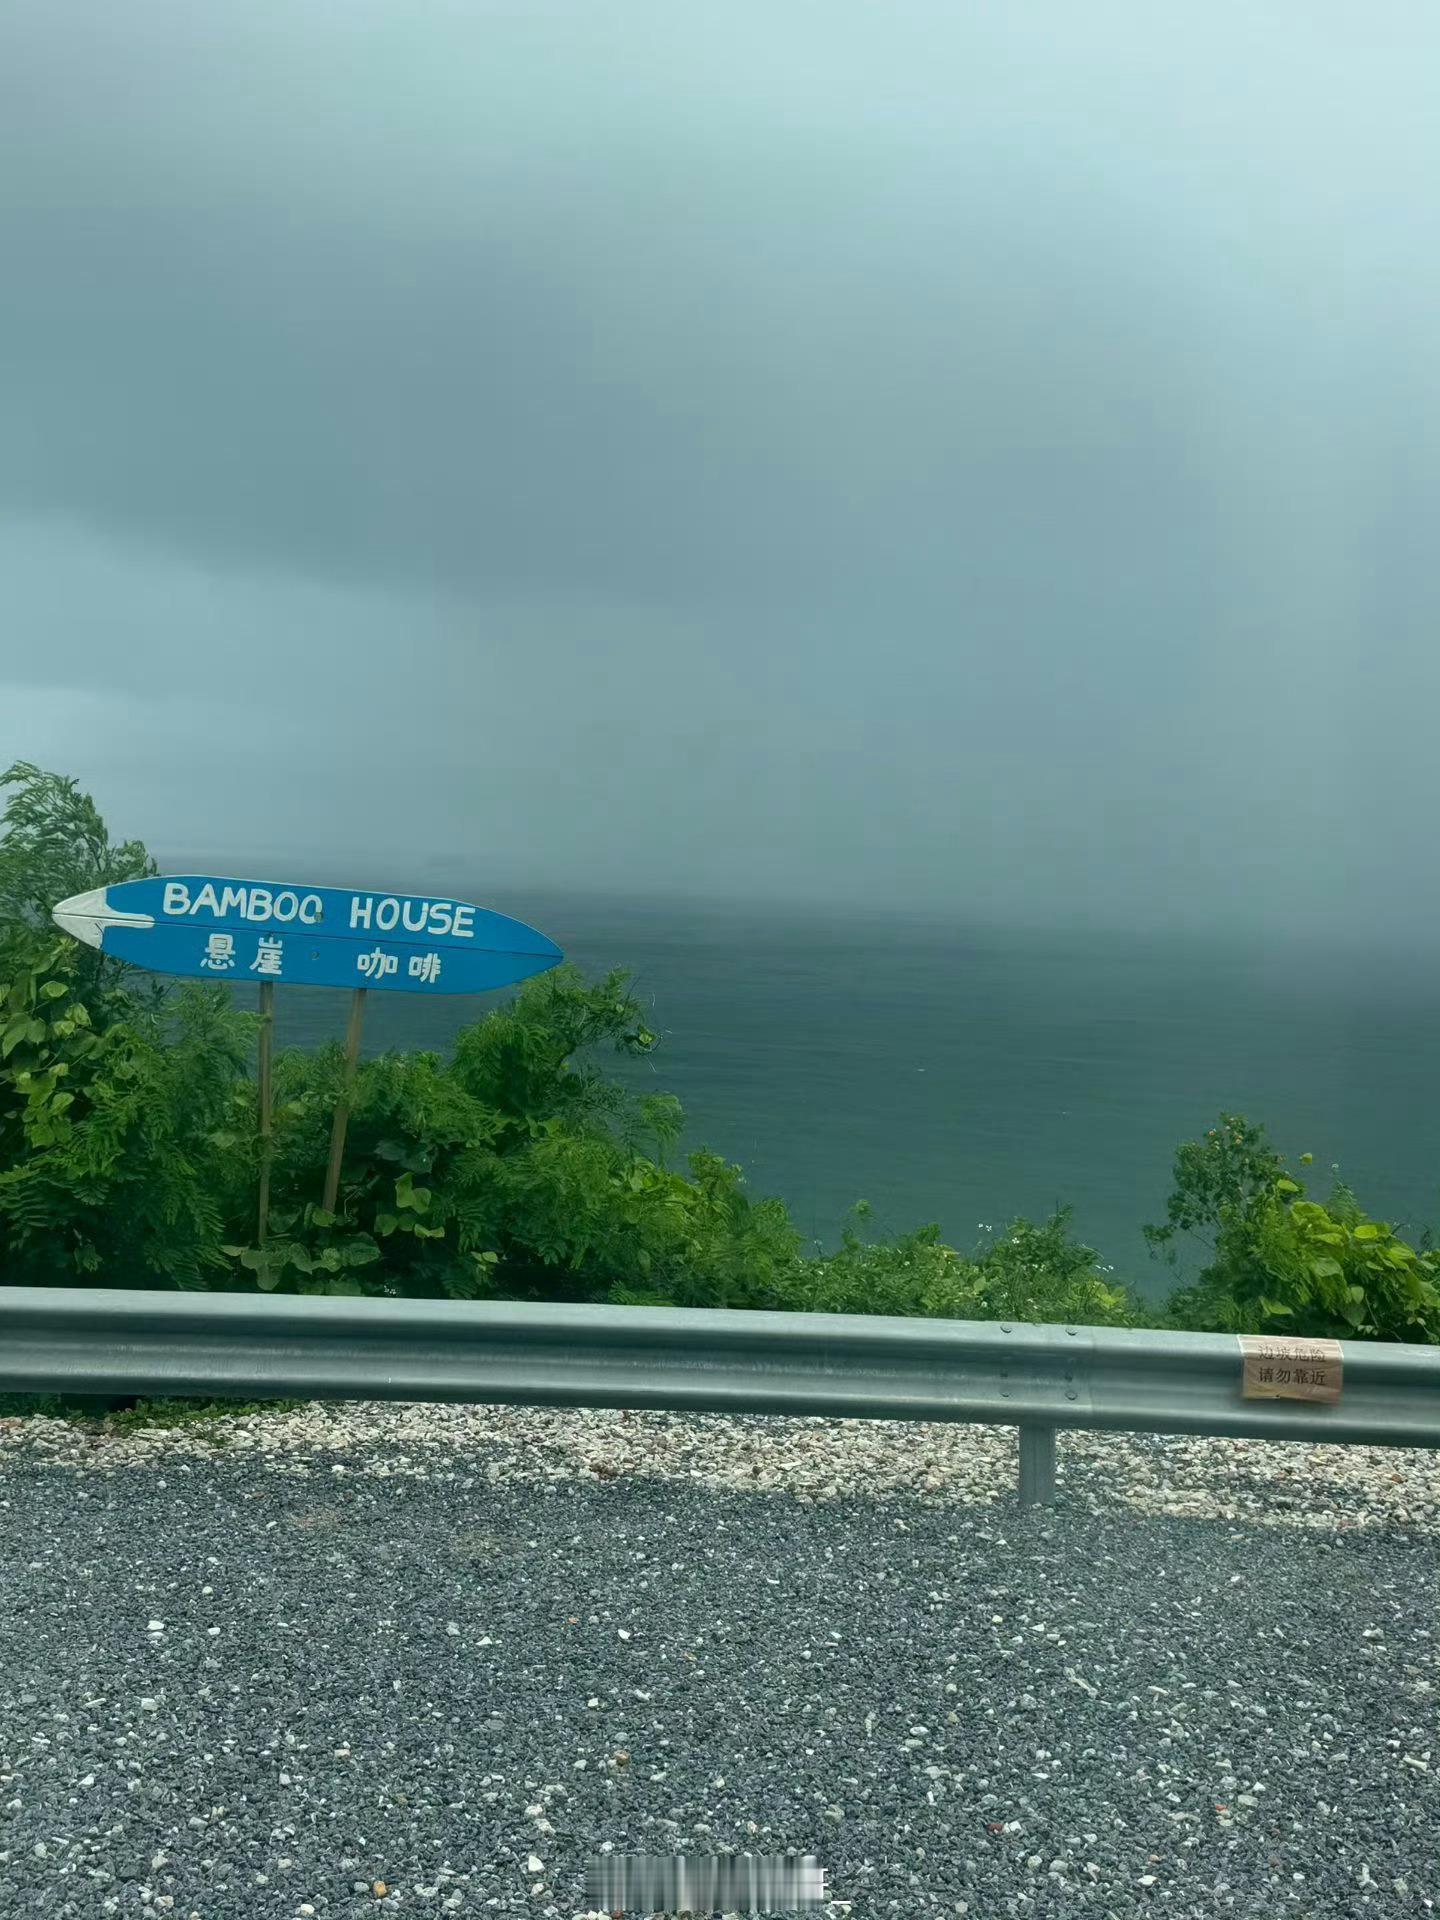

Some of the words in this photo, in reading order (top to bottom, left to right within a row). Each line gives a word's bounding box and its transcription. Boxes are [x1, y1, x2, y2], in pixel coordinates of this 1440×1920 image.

[162, 883, 323, 924] BAMBOO
[349, 897, 475, 938] HOUSE
[200, 934, 284, 975] 悬崖
[356, 952, 441, 983] 咖啡
[1259, 1367, 1326, 1386] 请勿靠近
